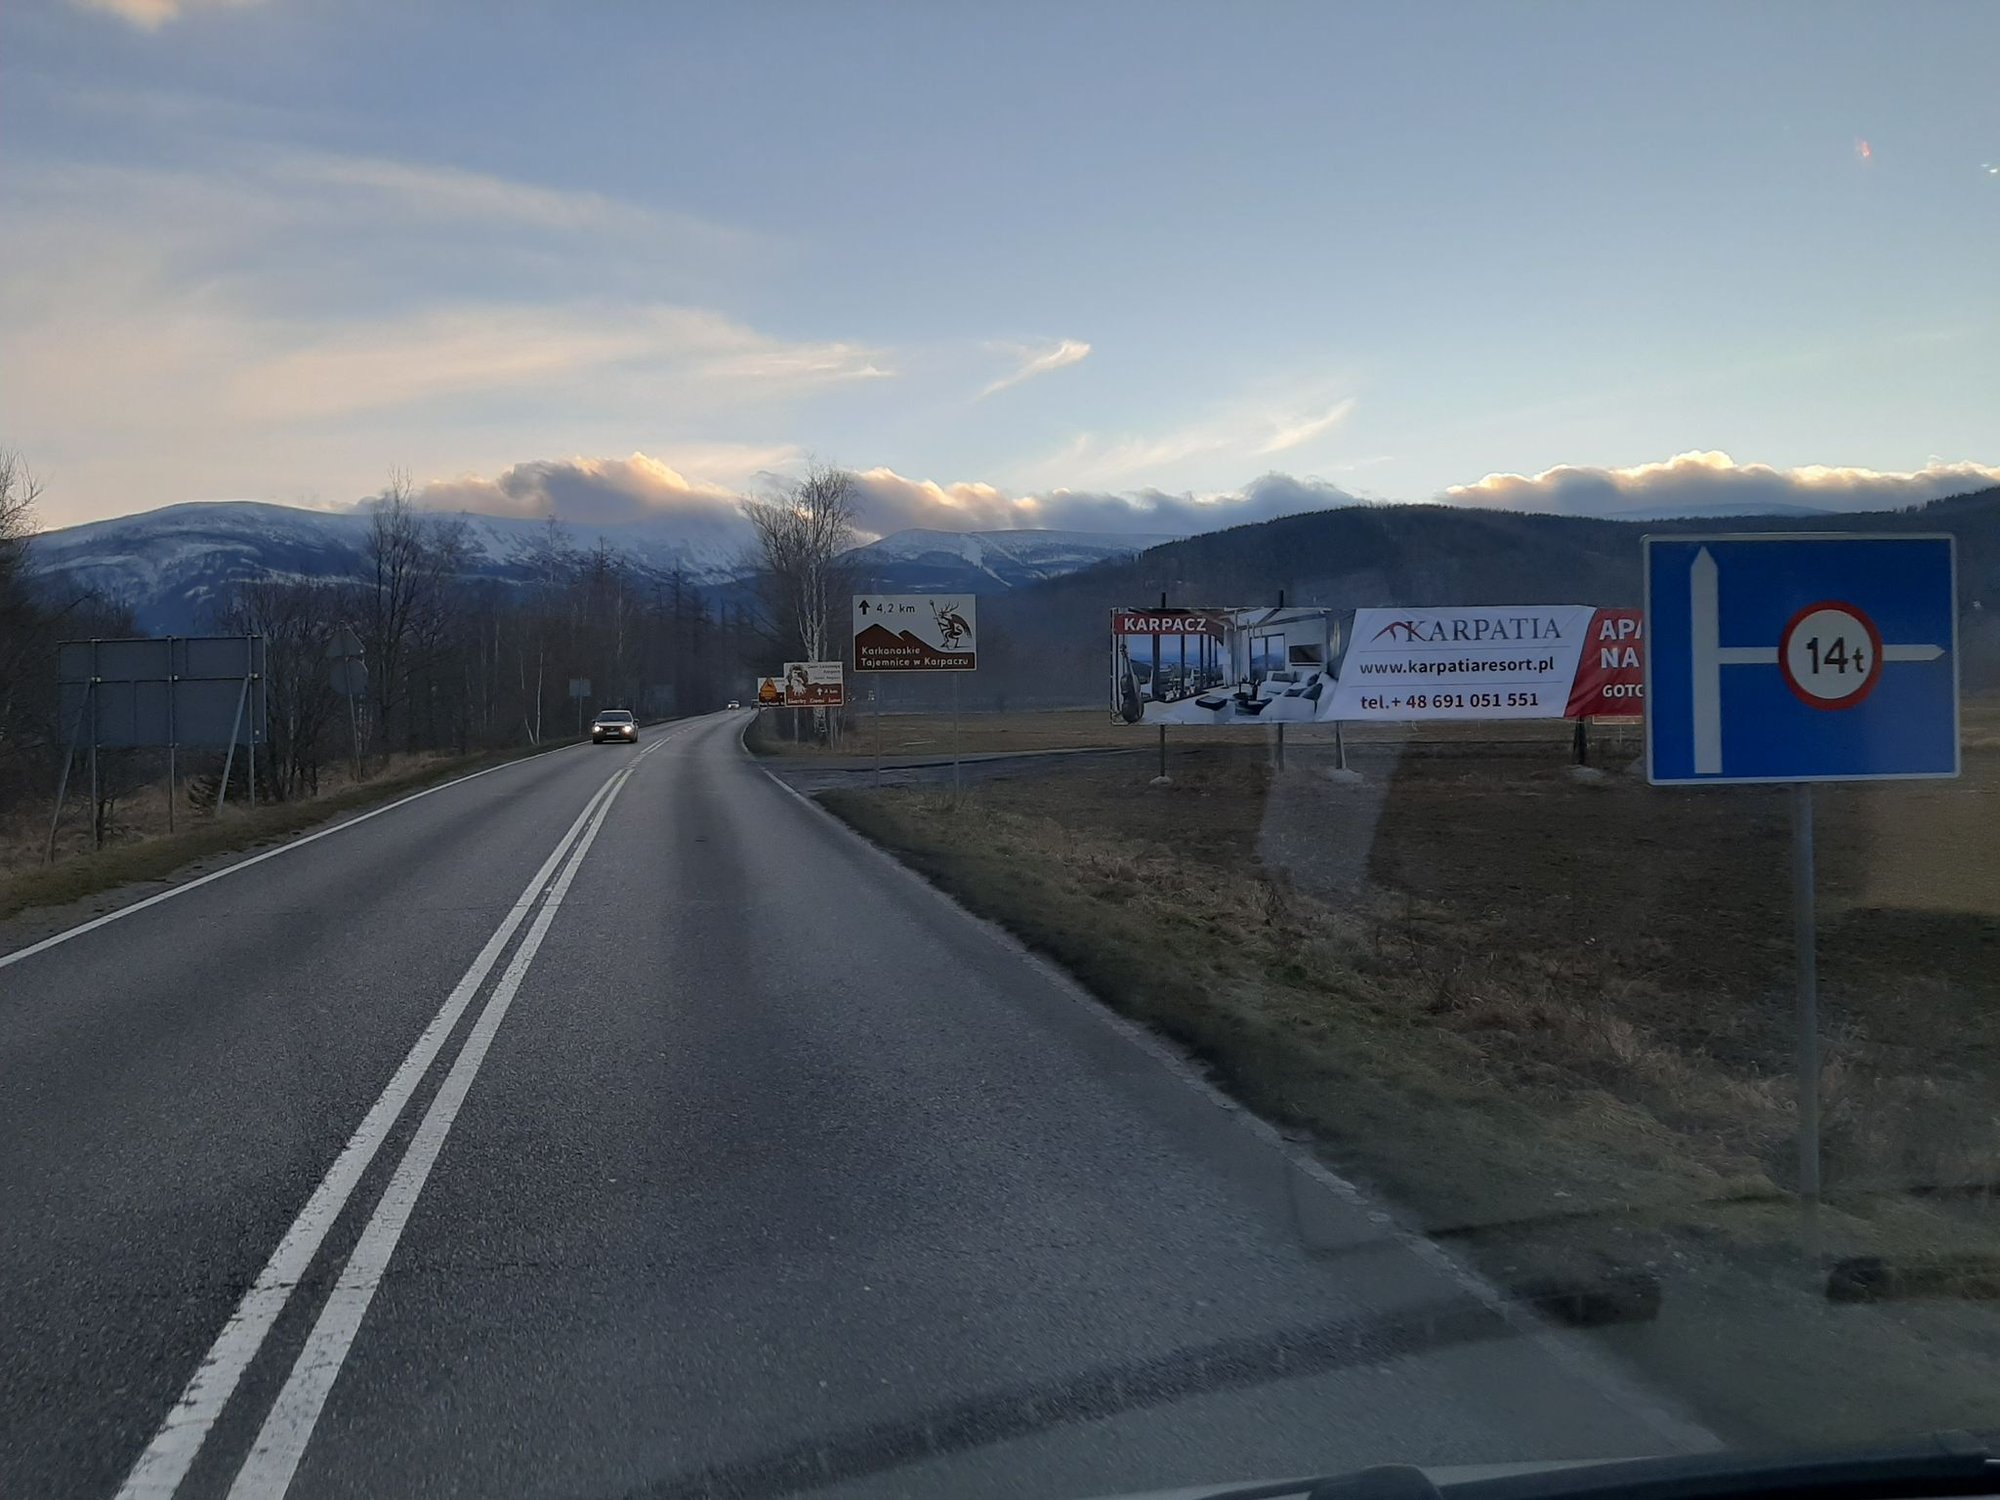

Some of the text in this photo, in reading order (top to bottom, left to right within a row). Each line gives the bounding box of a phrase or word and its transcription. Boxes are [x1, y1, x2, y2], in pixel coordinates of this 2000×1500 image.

[876, 603, 916, 614] 4,2 km
[1123, 617, 1207, 632] KARPACZ
[1405, 617, 1562, 642] KARPATIA
[861, 646, 921, 656] Karkonoskie
[1600, 646, 1640, 668] NA
[861, 657, 910, 668] Tajemnice
[924, 657, 969, 668] Karpaczu
[1359, 656, 1554, 676] www.karpatiaresort.pl
[1432, 693, 1464, 708] 691
[1470, 693, 1501, 708] 051
[1507, 692, 1539, 707] 551
